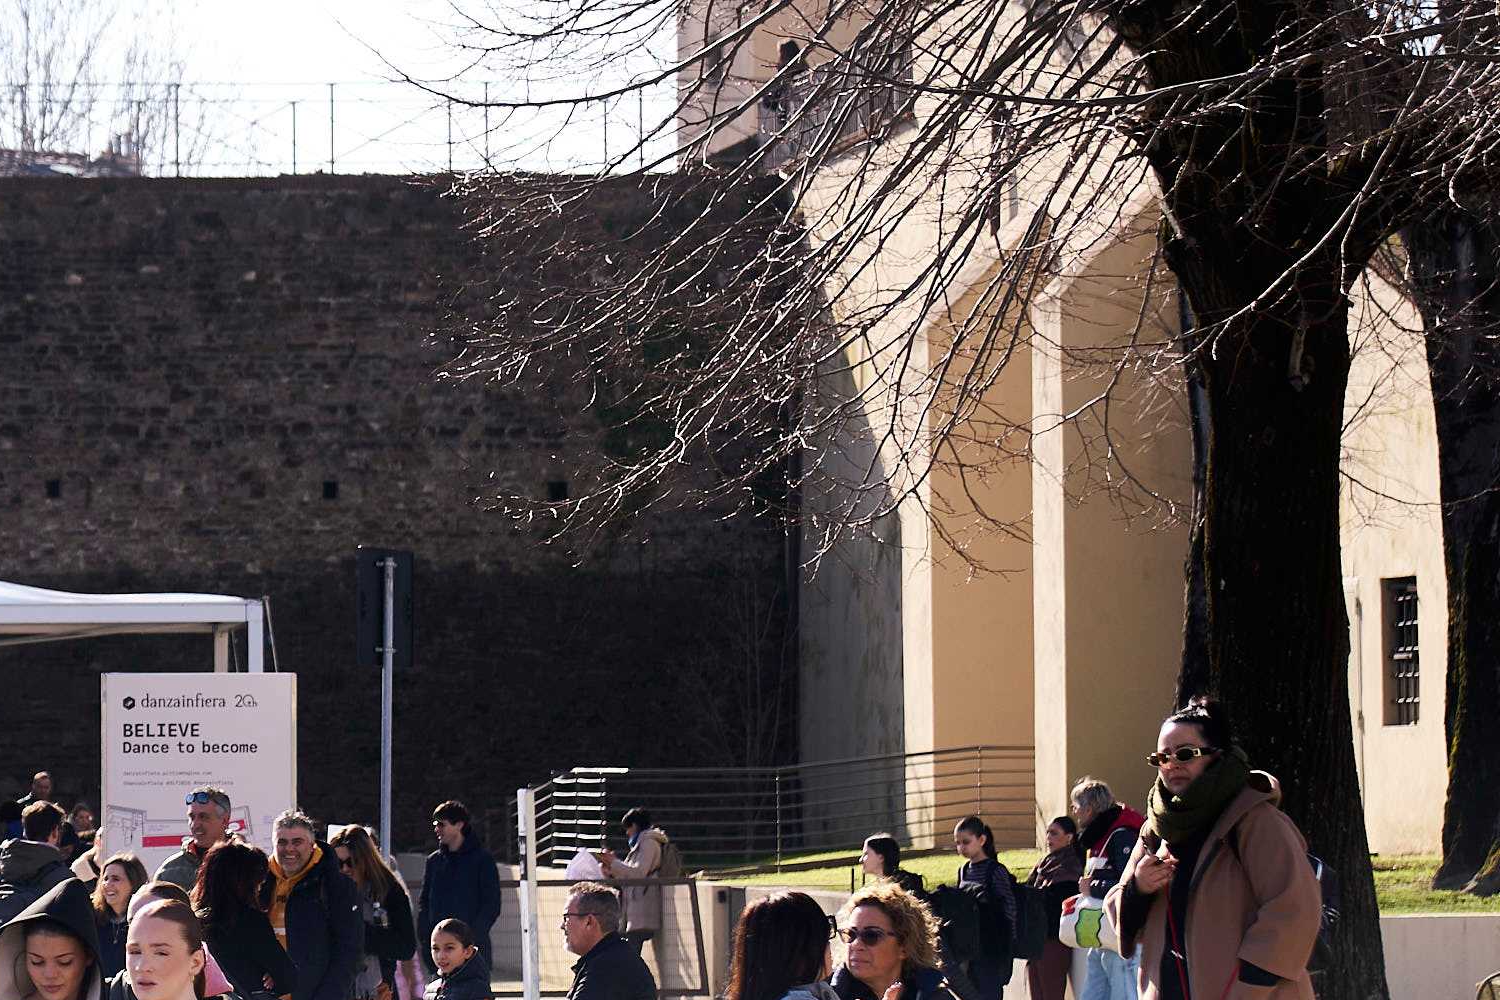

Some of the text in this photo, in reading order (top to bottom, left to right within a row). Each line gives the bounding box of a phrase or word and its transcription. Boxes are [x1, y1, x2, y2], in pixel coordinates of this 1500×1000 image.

[141, 693, 226, 708] danzainfiera
[123, 723, 200, 738] BELIEVE
[123, 740, 258, 754] Dance to become
